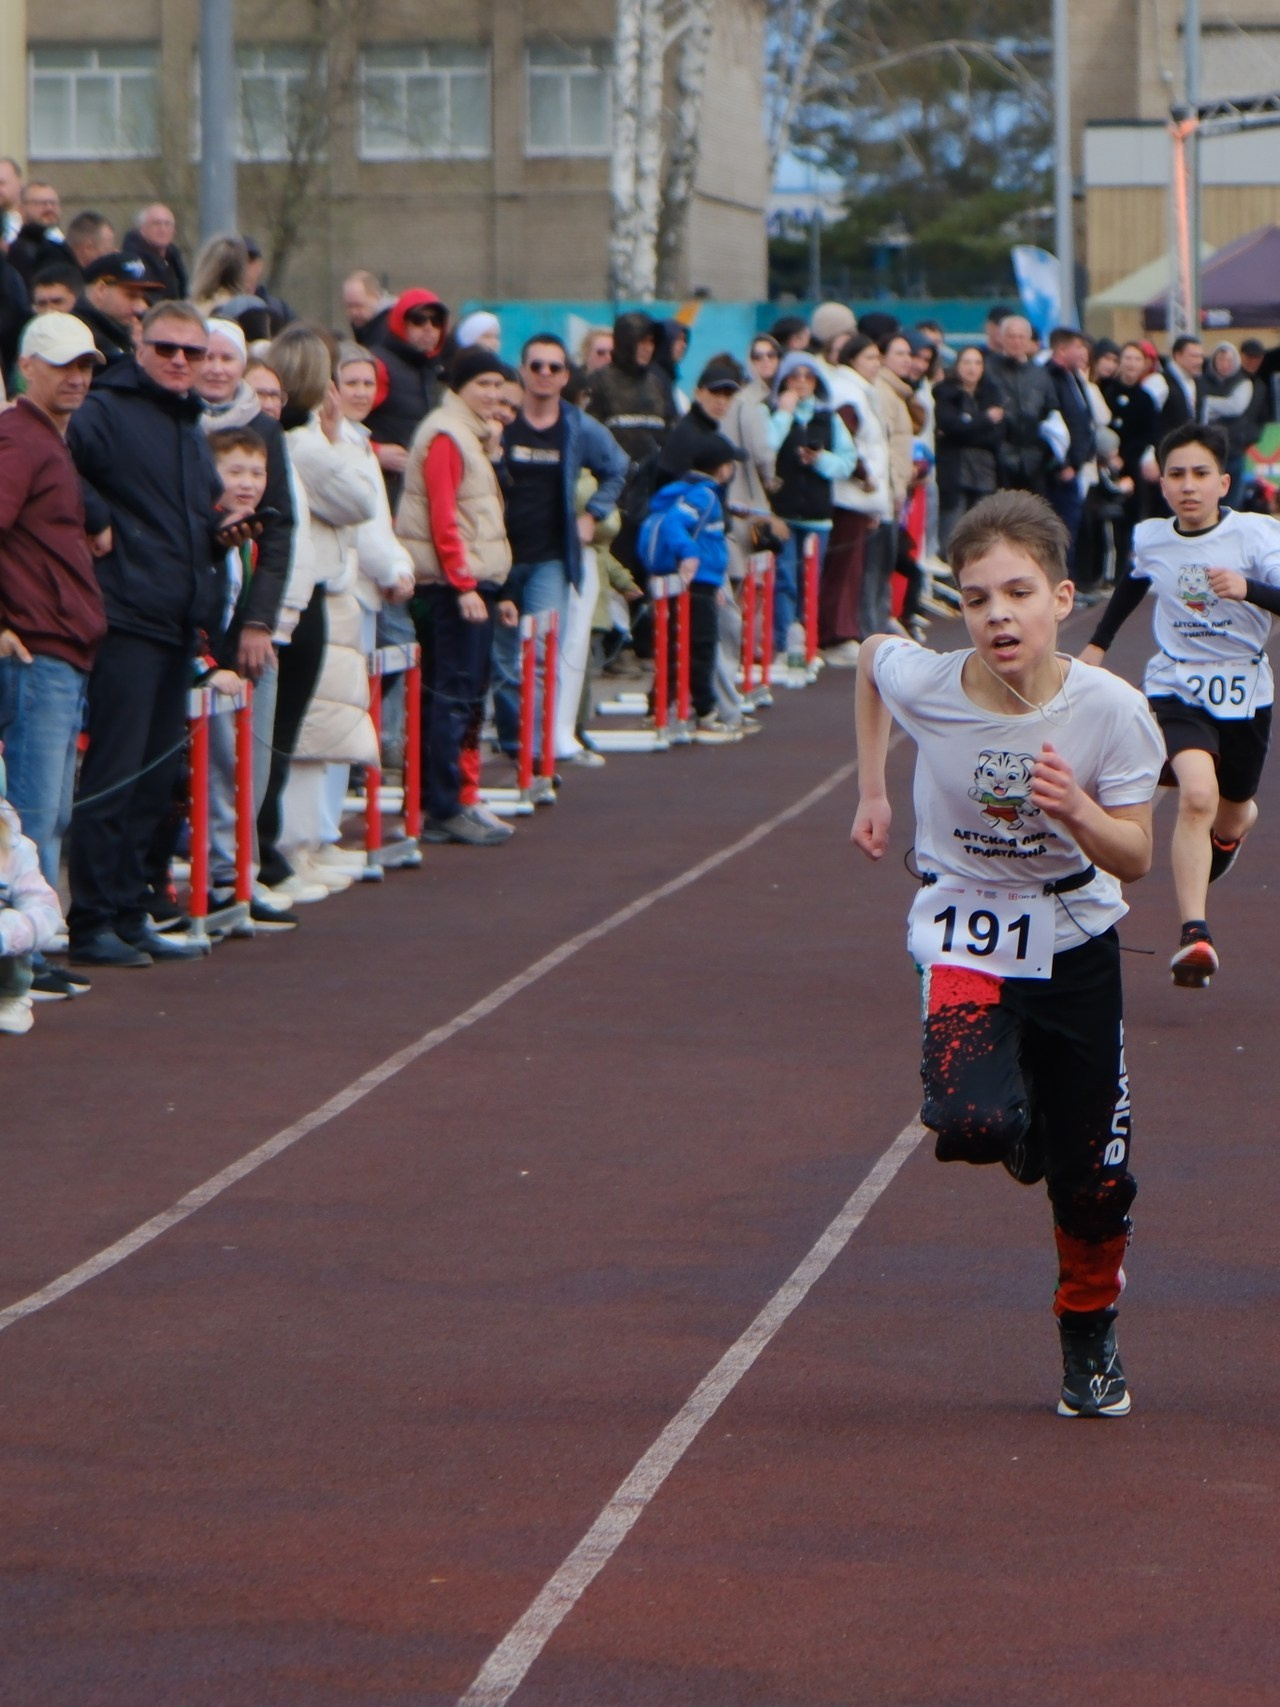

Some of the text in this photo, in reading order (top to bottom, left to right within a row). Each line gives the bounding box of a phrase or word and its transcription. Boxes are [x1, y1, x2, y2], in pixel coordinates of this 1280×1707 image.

[1187, 674, 1246, 706] 205
[964, 845, 1047, 859] ТРИАТЛОНА
[934, 905, 1030, 960] 191
